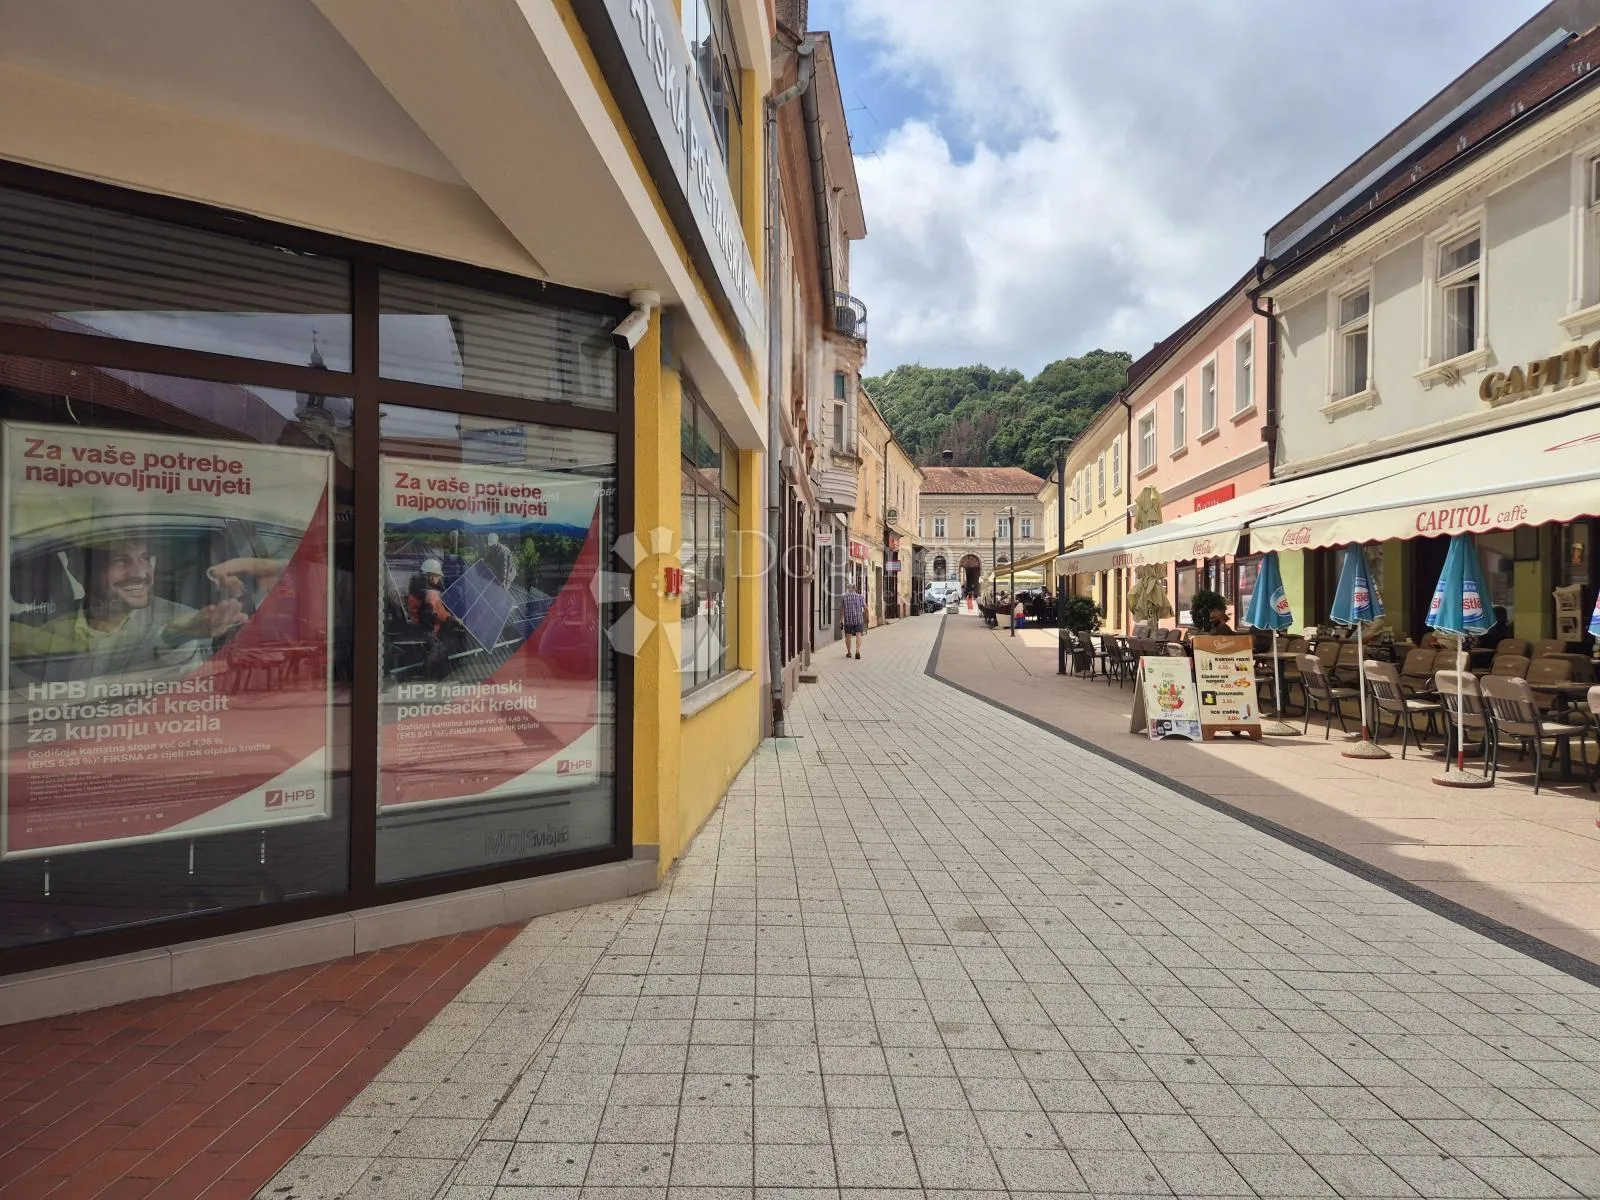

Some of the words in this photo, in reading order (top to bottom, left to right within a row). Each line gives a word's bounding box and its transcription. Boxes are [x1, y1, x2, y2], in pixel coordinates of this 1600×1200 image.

[24, 438, 61, 461] Za
[72, 445, 136, 465] vaše
[144, 451, 243, 474] potrebe
[25, 464, 181, 492] najpovoljniji
[188, 477, 251, 497] uvjeti
[395, 472, 420, 489] Za
[427, 477, 469, 493] vaše
[475, 483, 542, 499] potrebe
[396, 494, 500, 514] najpovoljniji
[505, 501, 548, 517] uvjeti
[1416, 504, 1491, 532] CAPITOL
[1113, 553, 1133, 566] CAPITOL
[28, 681, 86, 702] HPB
[93, 676, 214, 704] namjenski
[398, 684, 437, 700] HPB
[441, 680, 522, 701] namjenski
[28, 698, 158, 726] potrošački
[165, 696, 230, 715] kredit
[397, 699, 485, 721] potrošački
[489, 695, 537, 711] krediti
[27, 726, 57, 743] za
[65, 717, 148, 743] kupnju
[155, 714, 221, 733] vozila
[79, 743, 125, 755] kamatna
[128, 741, 156, 752] stopa
[178, 739, 190, 748] od
[103, 752, 144, 763] FIKSNA
[186, 747, 201, 757] rok
[570, 760, 592, 770] HPB
[284, 790, 316, 803] HPB
